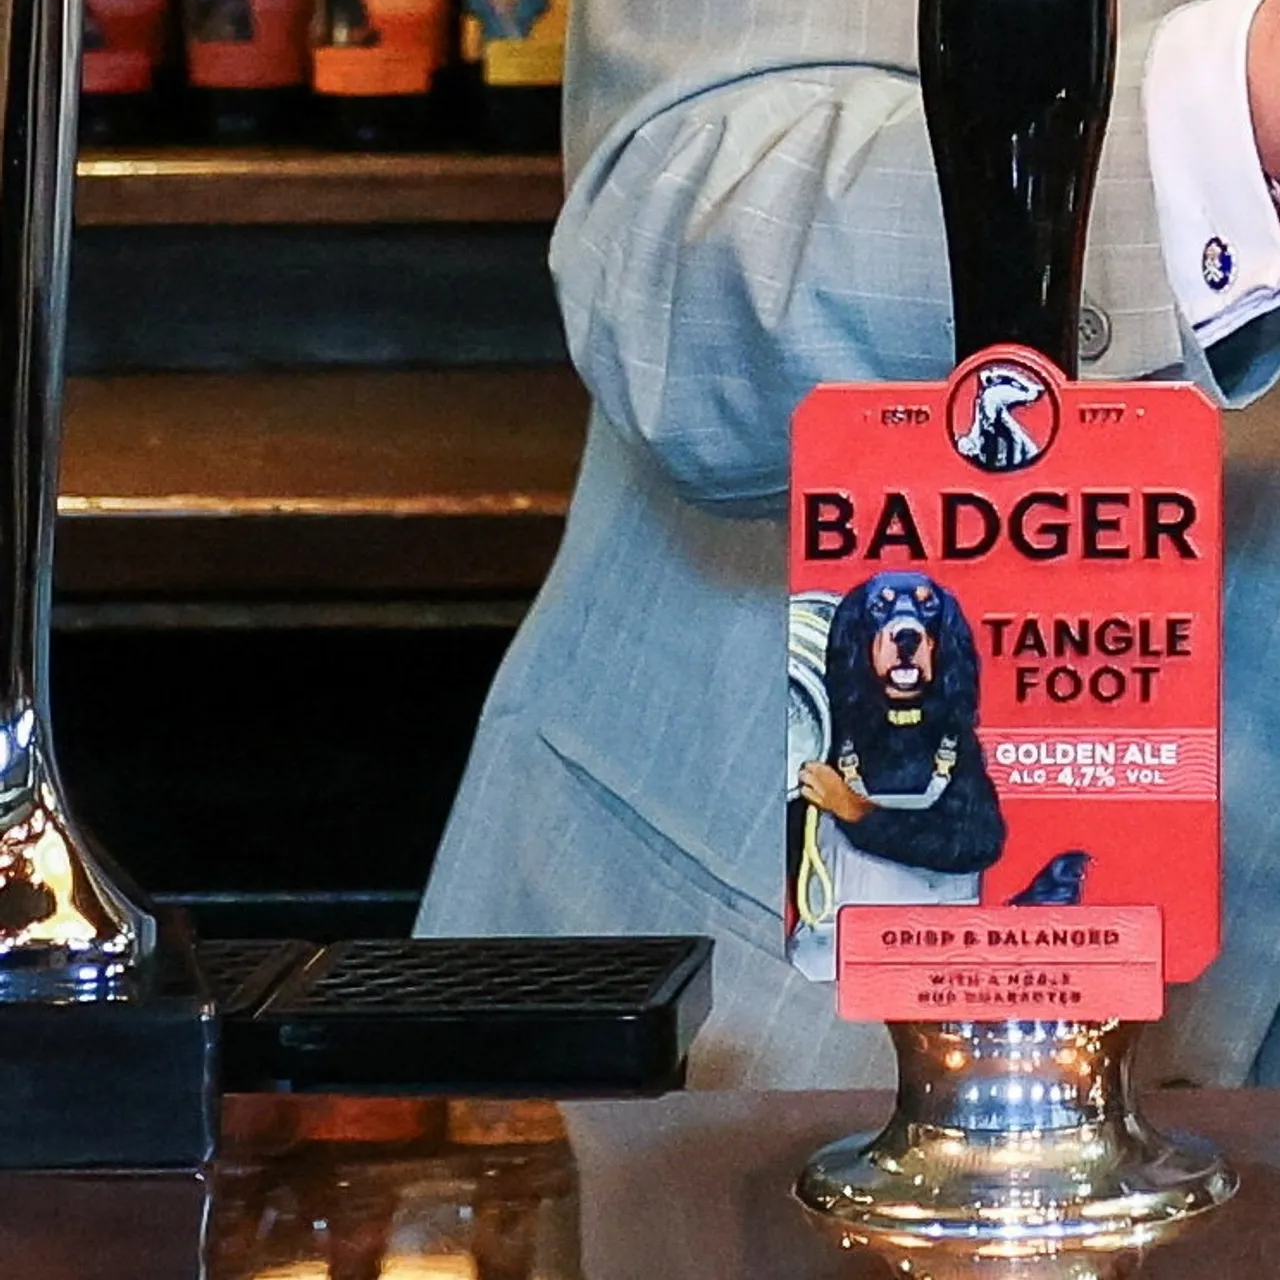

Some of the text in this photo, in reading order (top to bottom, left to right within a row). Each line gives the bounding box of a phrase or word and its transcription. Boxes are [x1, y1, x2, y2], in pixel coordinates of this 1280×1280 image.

[880, 402, 1127, 426] ESTD 1777
[803, 488, 1202, 563] BADGER
[982, 613, 1193, 658] TANGLE
[1014, 664, 1161, 705] FOOT
[995, 742, 1178, 765] GOLDEN ALE
[1008, 766, 1167, 788] ALC 4.7% VOL
[881, 928, 1120, 947] CRISP & BALANCED
